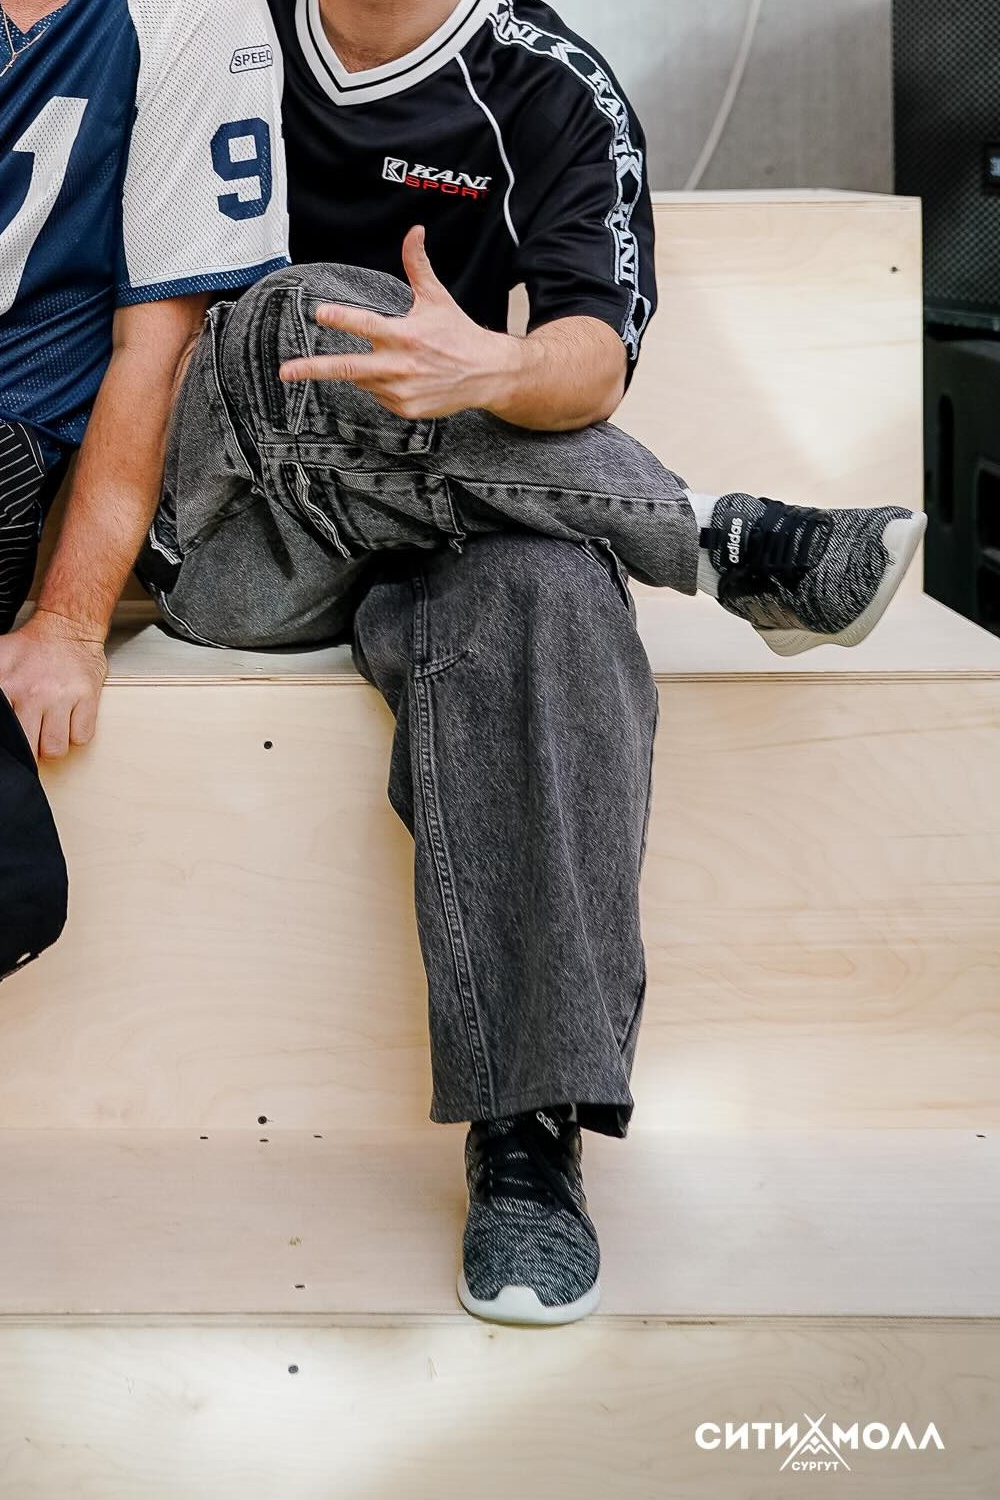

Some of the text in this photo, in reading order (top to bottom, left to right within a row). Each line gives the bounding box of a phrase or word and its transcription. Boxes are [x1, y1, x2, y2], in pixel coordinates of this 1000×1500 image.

[210, 117, 273, 221] 9
[408, 163, 492, 190] KANI
[726, 517, 743, 564] adidas
